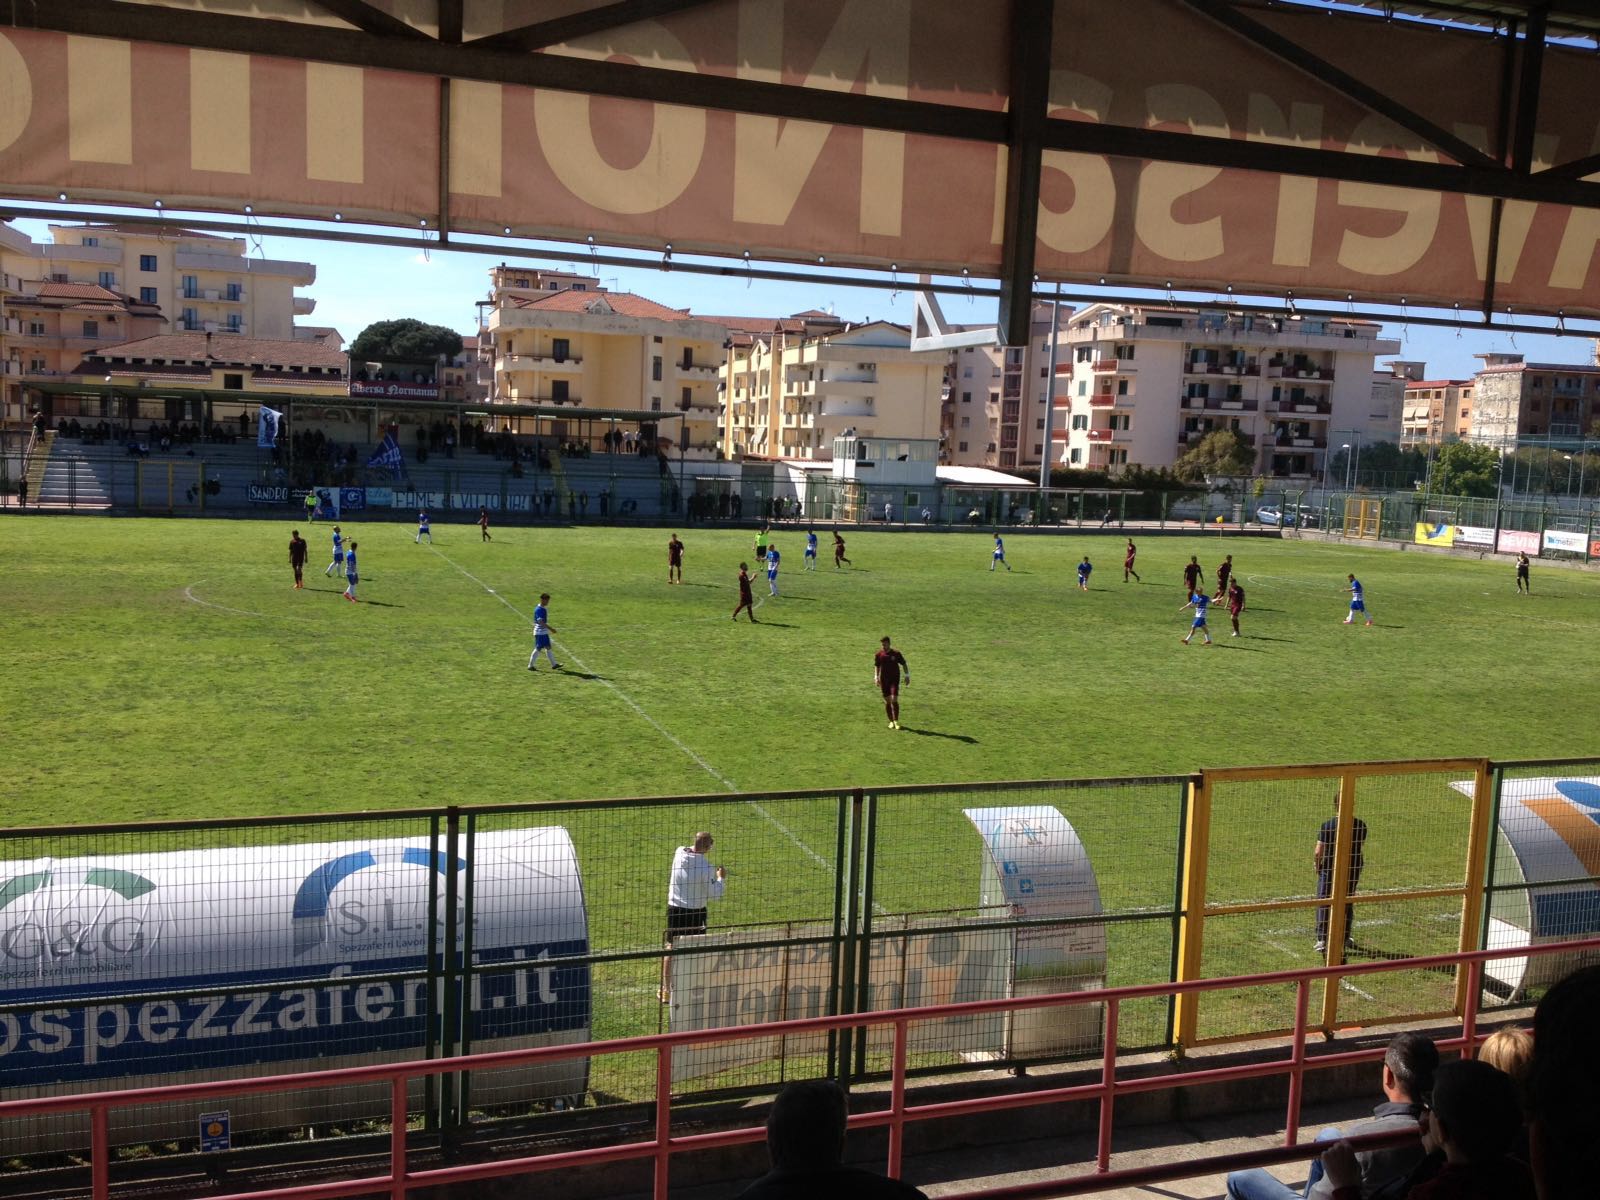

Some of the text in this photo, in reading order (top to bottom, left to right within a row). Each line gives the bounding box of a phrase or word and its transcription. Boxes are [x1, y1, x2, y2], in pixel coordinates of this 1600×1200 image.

[386, 384, 438, 397] Normanna
[251, 486, 288, 500] SANDRO
[396, 491, 436, 508] FAME
[461, 492, 529, 510] VITTOIA!
[338, 940, 393, 953] Spezzaferri
[396, 937, 426, 948] Lavori
[65, 961, 132, 975] Immobiliare
